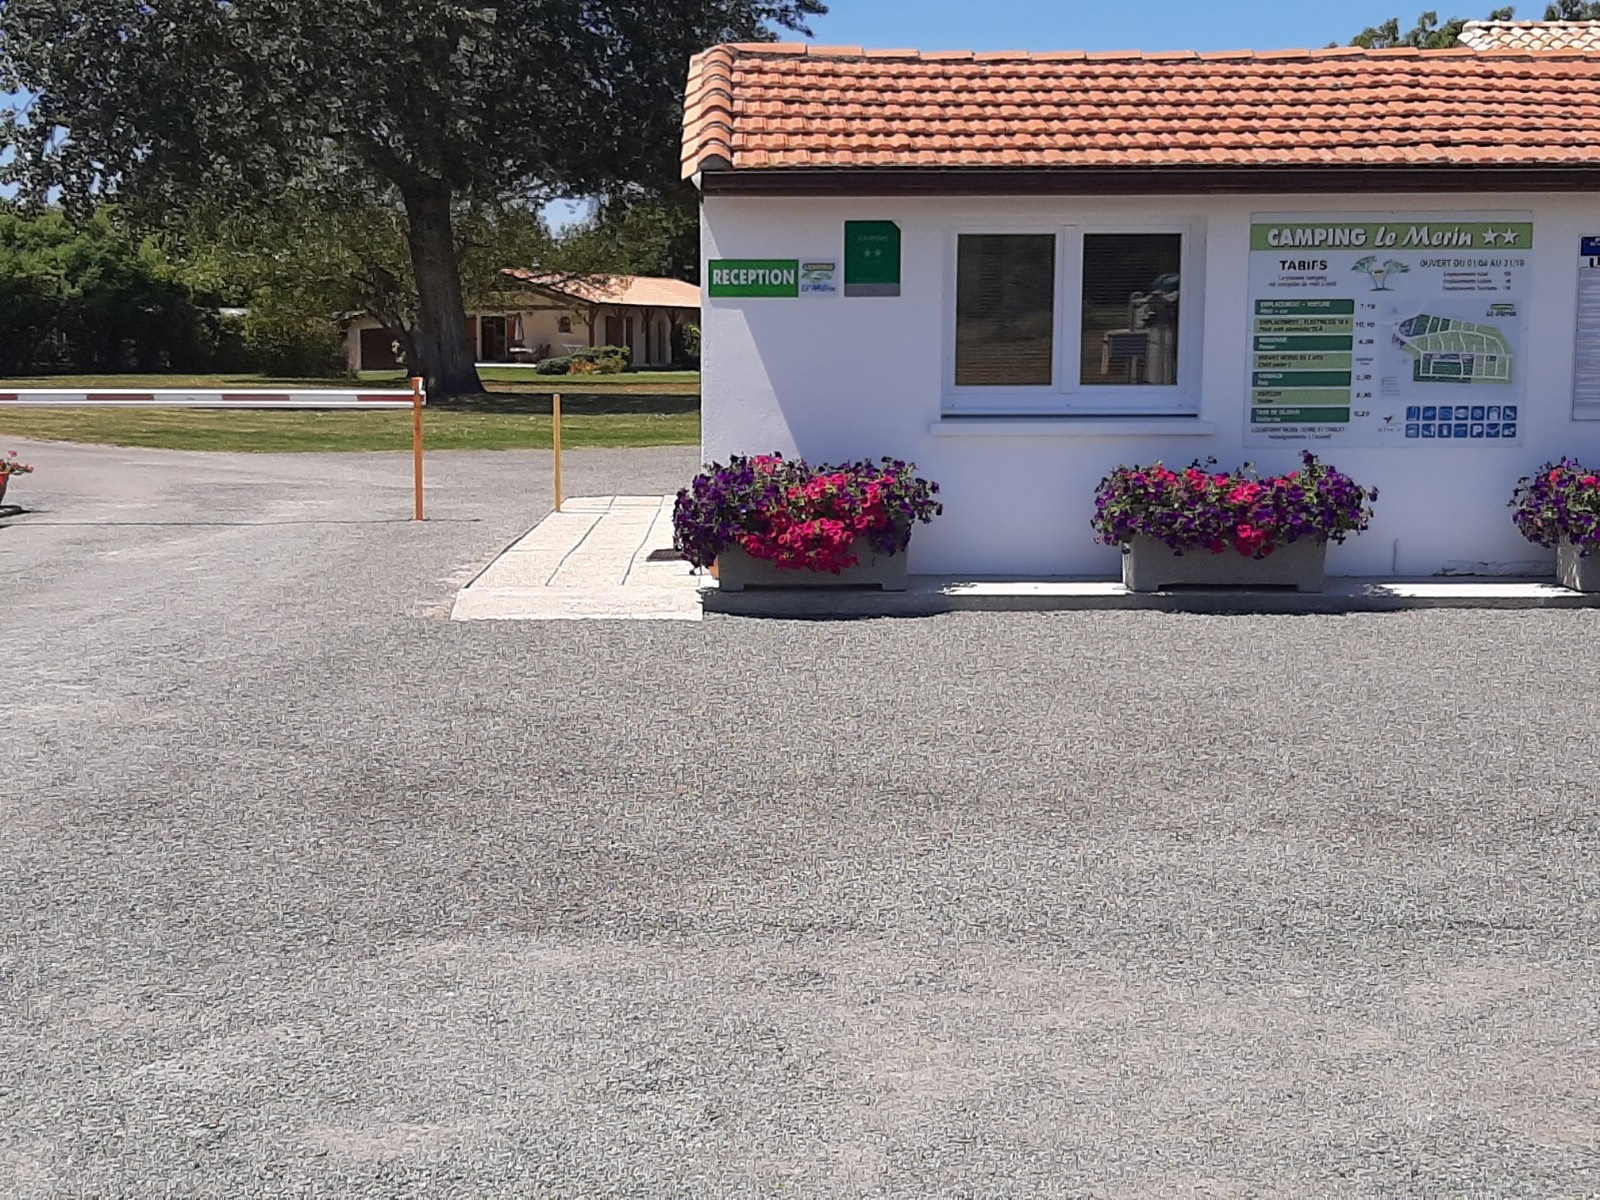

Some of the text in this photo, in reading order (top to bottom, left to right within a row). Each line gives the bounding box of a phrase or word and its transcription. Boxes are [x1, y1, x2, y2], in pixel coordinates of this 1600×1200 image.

[1267, 227, 1367, 247] CAMPING
[1374, 225, 1397, 247] Le
[1279, 260, 1328, 271] TARIFS
[1420, 259, 1451, 268] OUVERT
[1453, 259, 1466, 268] DU
[1489, 259, 1502, 268] AU
[712, 268, 795, 286] RECEPTION
